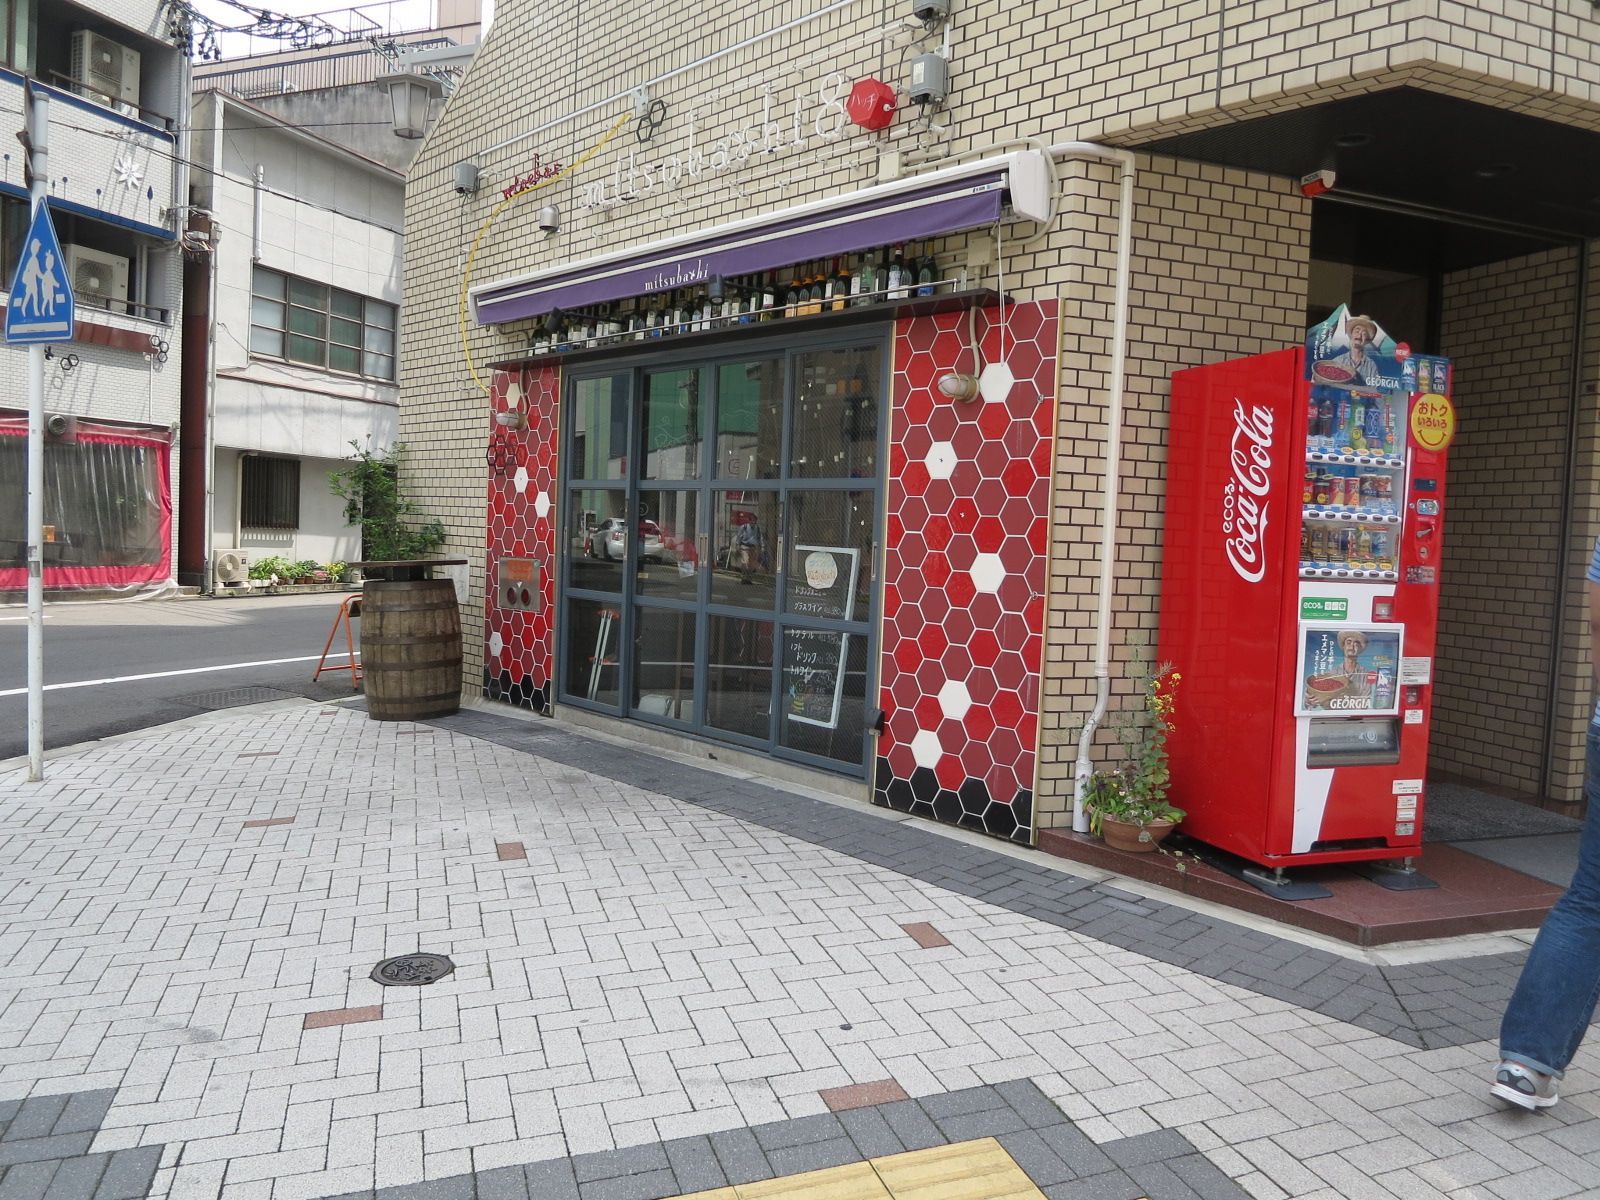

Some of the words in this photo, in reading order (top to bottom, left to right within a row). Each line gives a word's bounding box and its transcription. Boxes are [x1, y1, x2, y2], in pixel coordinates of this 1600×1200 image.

[1365, 376, 1399, 388] GEORGIA
[1418, 402, 1447, 416] おトク
[1417, 416, 1447, 429] いろいろ
[1225, 397, 1273, 583] Coca-Cola
[794, 602, 823, 613] グラスワイン
[1330, 698, 1371, 709] GEORGIA
